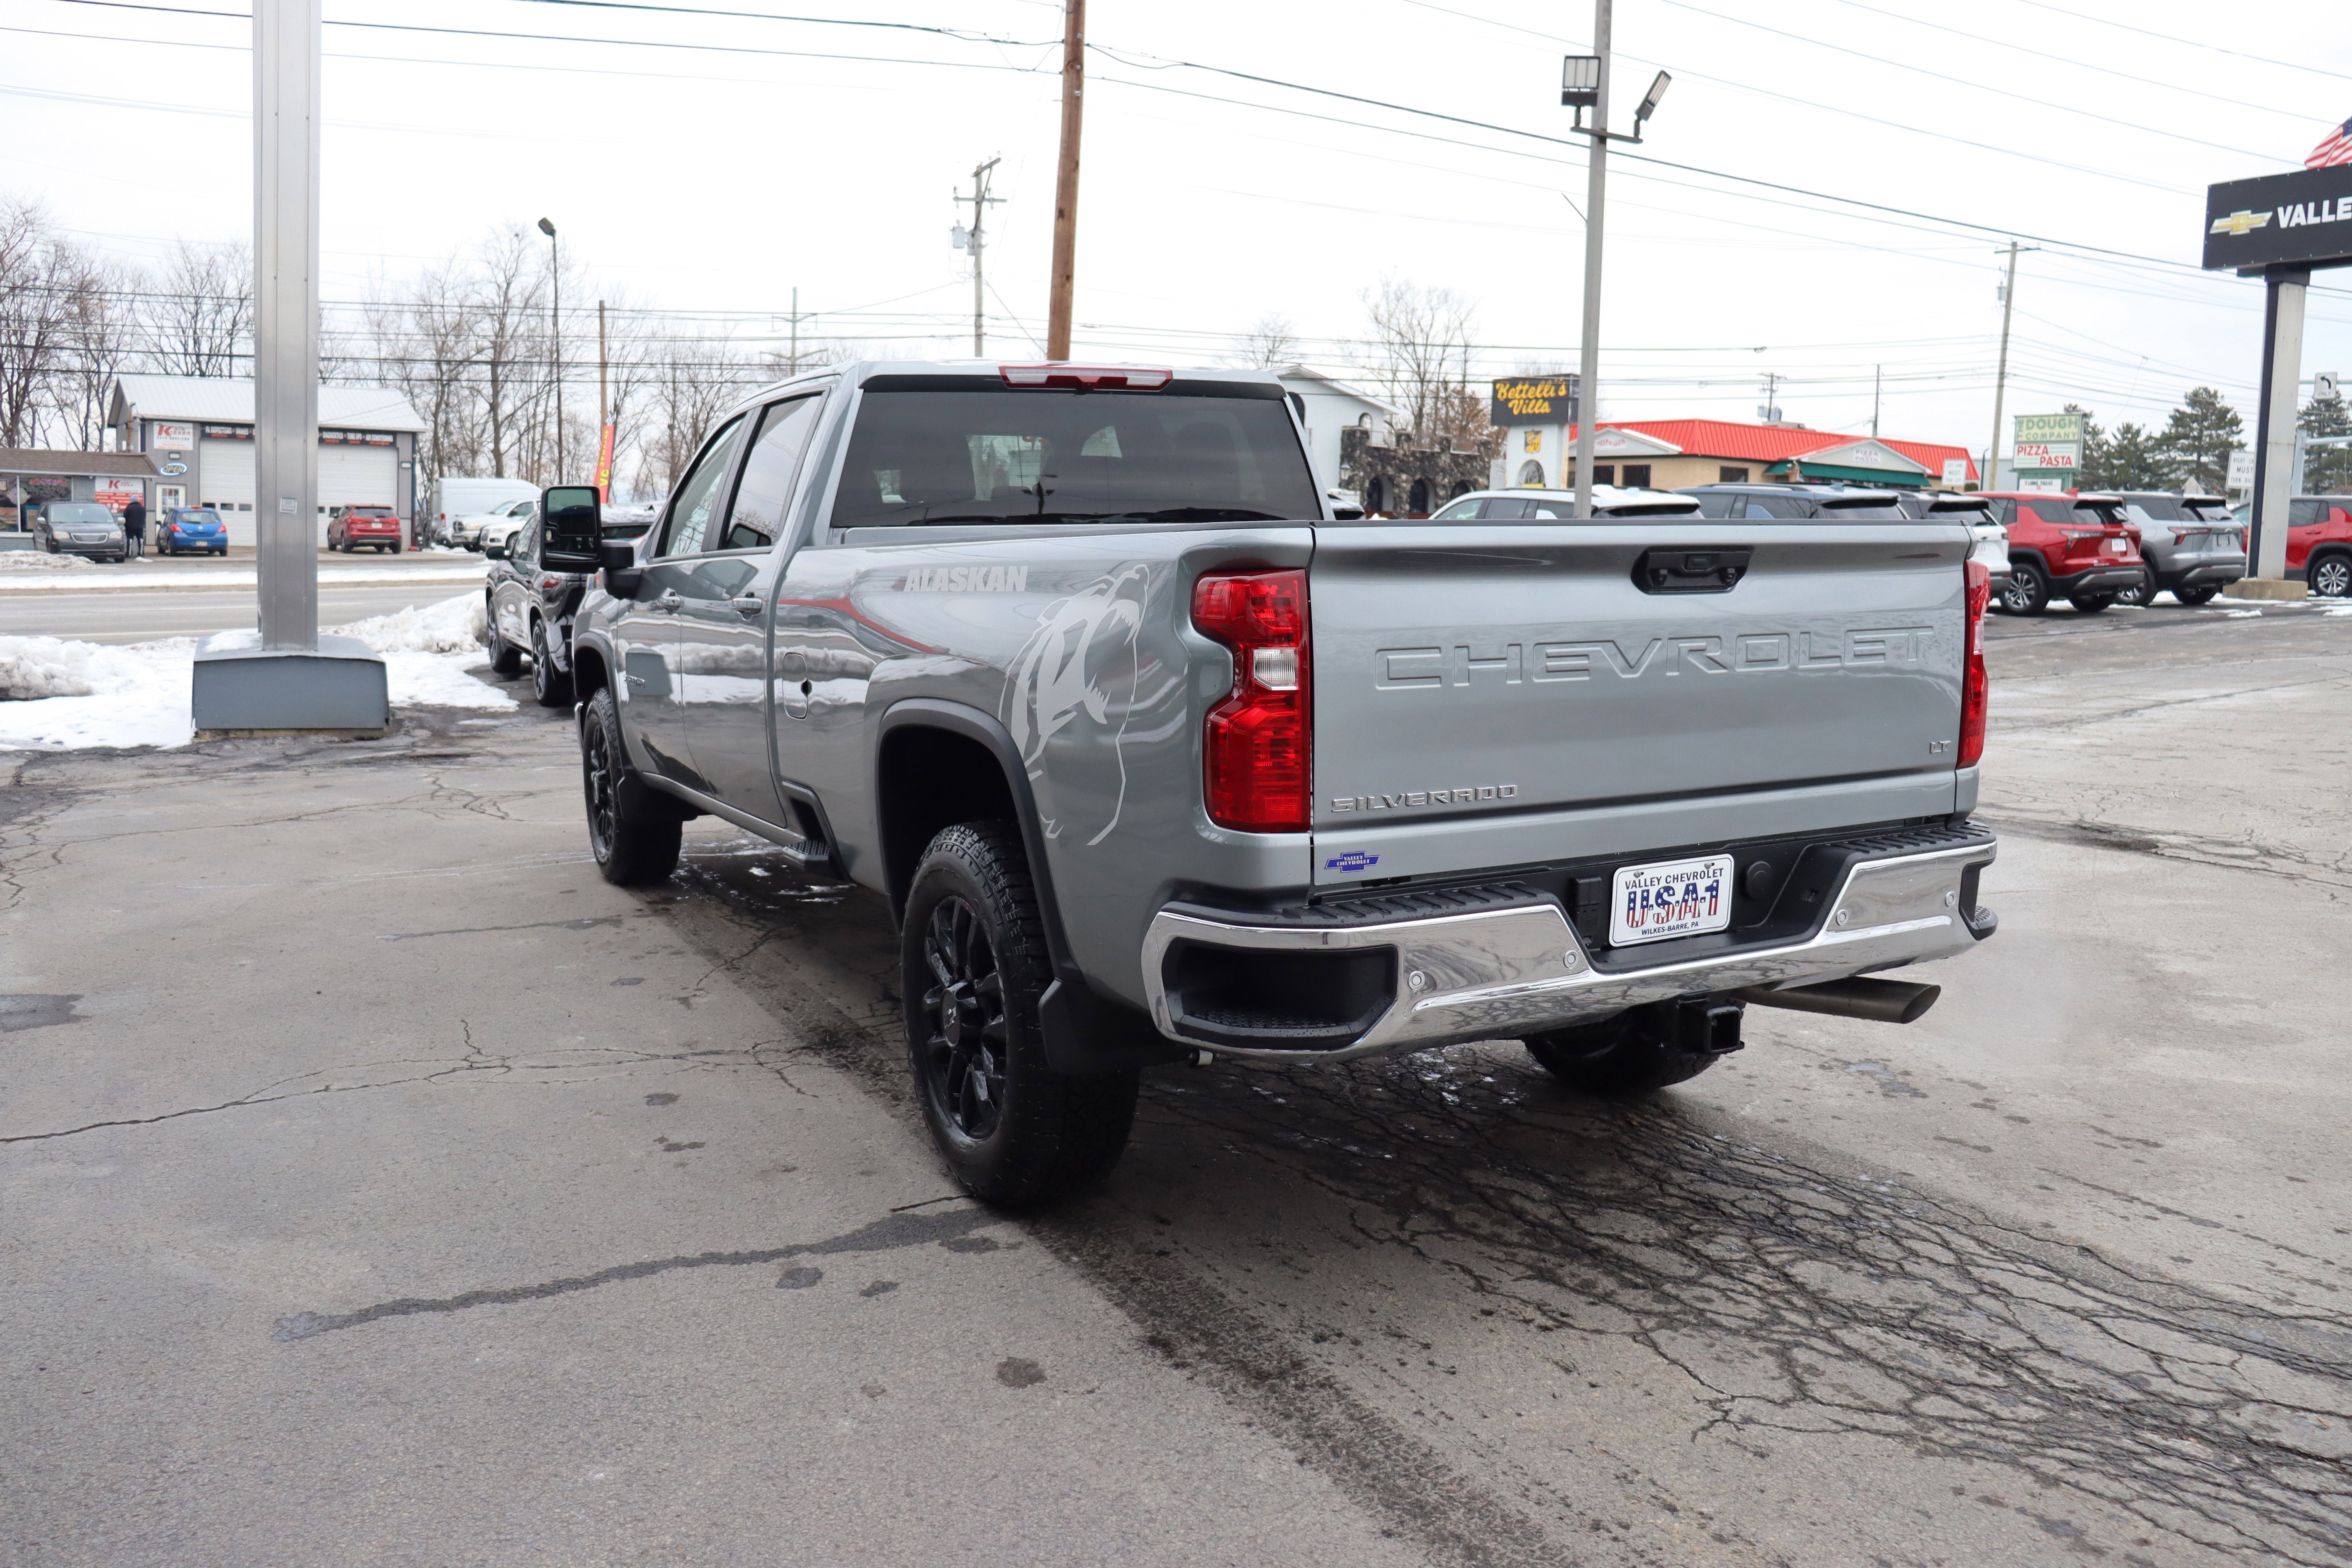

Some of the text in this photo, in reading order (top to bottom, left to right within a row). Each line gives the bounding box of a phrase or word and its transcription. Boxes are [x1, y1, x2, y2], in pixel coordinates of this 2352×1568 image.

[1508, 399, 1551, 415] Villa
[2026, 418, 2078, 430] DOUGH
[2026, 432, 2077, 440] COMPANY
[2017, 444, 2049, 456] PIZZA
[2040, 456, 2072, 466] PASTA
[903, 566, 1028, 592] ALASKAN
[1375, 626, 1933, 690] CHEVROLET
[1929, 740, 1951, 754] LT
[1331, 784, 1518, 812] SILVERADO
[1625, 868, 1724, 890] VALLEY CHEVROLET
[1641, 922, 1689, 935] WILKES-BARRE,
